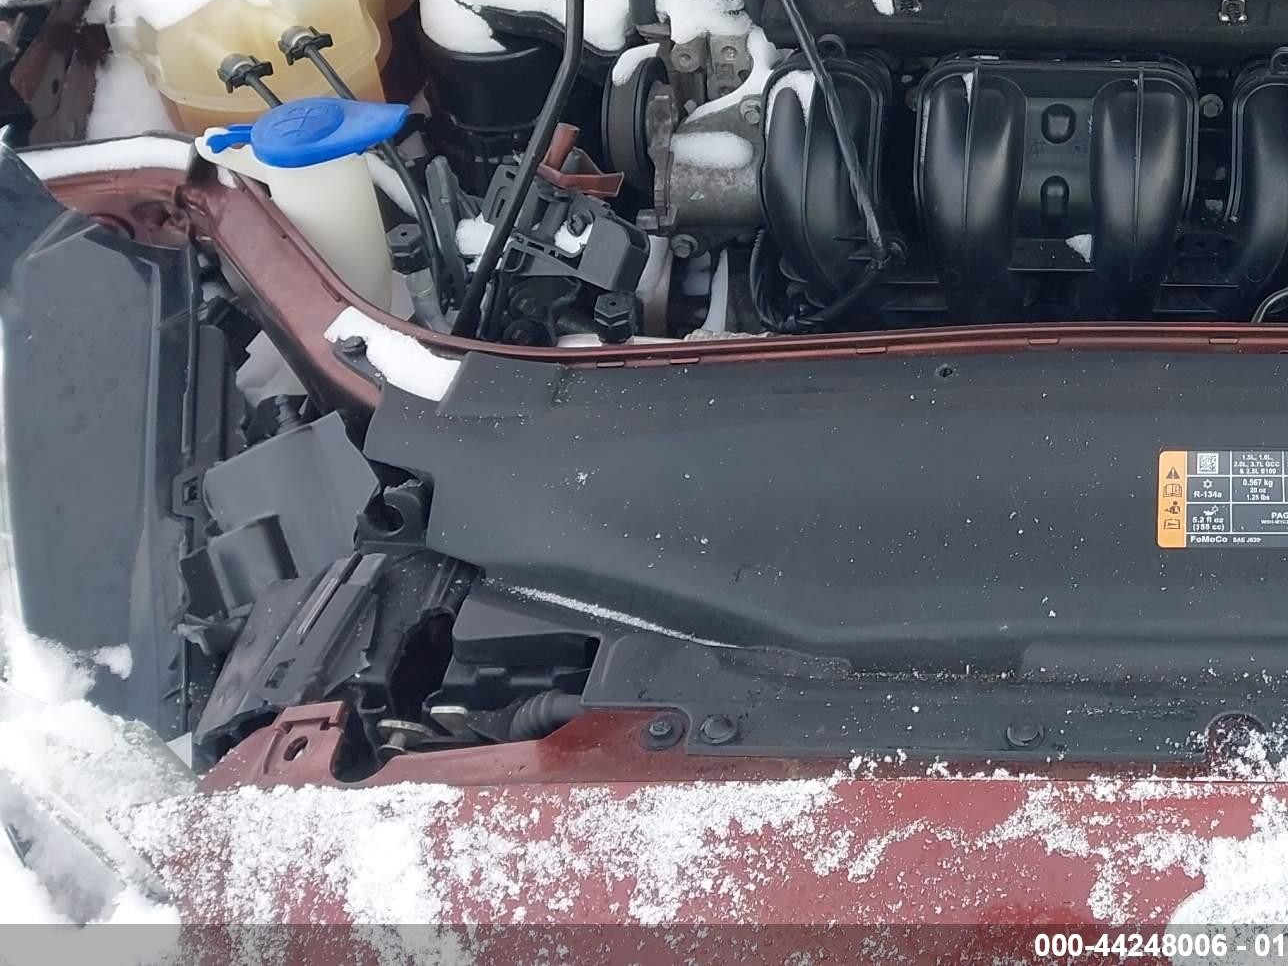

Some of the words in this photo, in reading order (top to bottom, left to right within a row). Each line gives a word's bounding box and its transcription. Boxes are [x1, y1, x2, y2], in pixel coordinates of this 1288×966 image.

[1264, 479, 1273, 488] kg
[1193, 491, 1222, 499] R-134a
[1212, 523, 1225, 531] cc)
